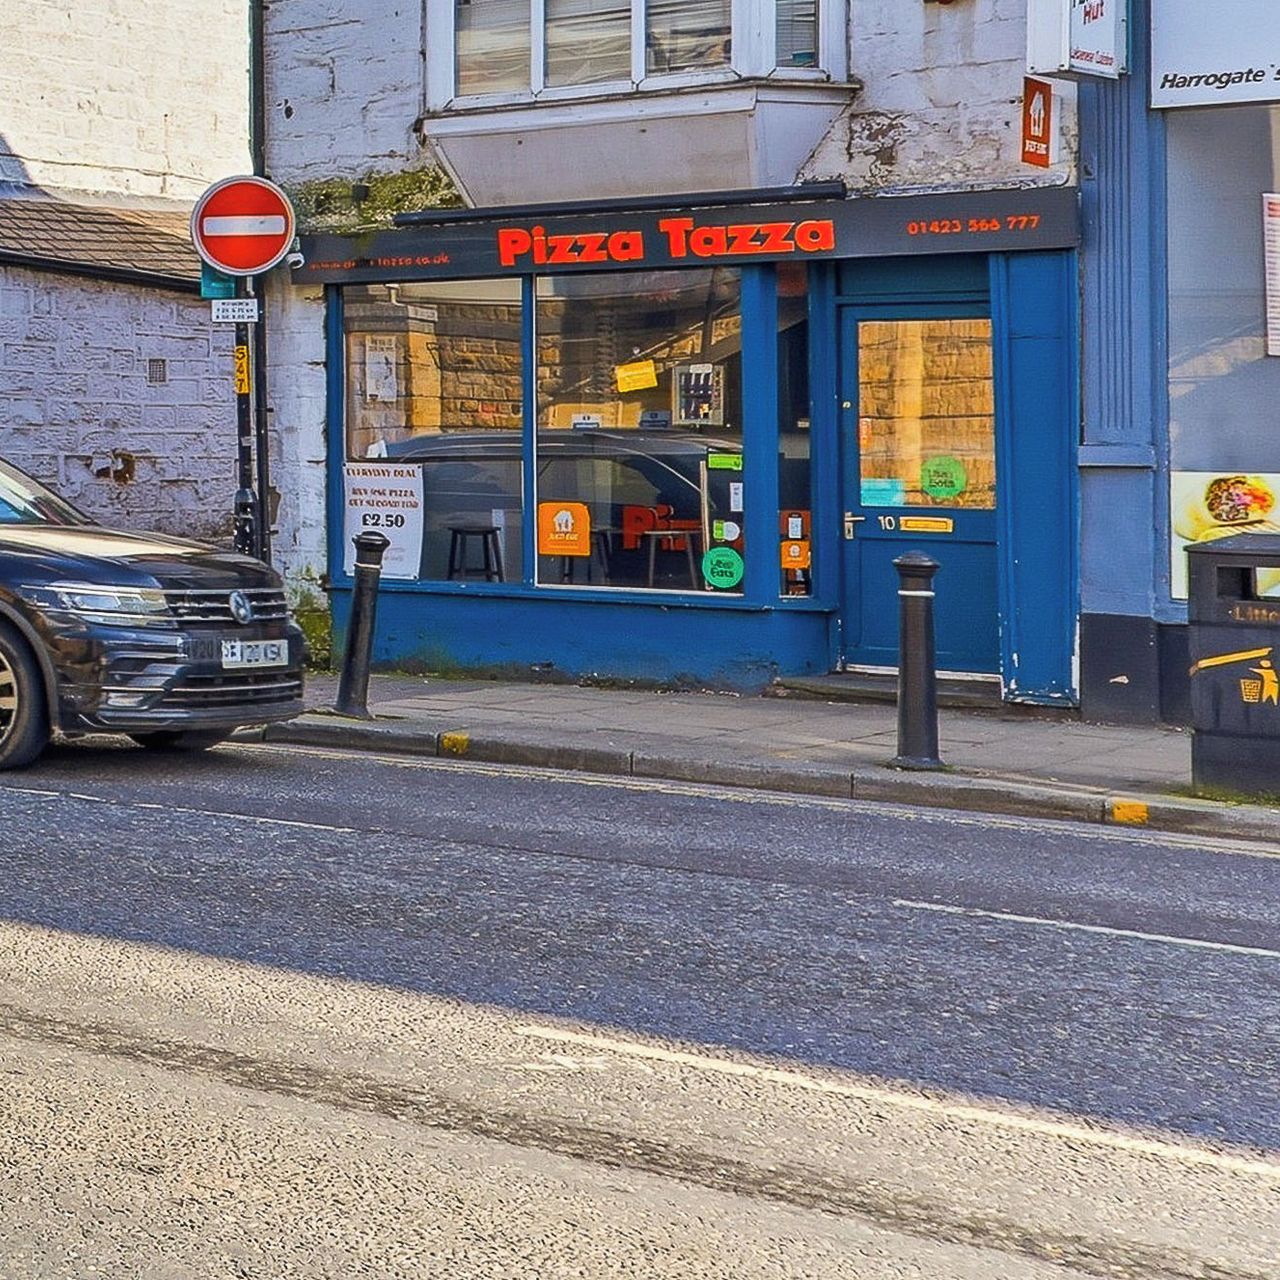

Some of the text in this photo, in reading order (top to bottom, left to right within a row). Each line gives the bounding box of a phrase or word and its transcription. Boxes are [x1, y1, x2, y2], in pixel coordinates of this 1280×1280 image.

[1083, 0, 1104, 25] Hut
[907, 220, 961, 235] 01423
[1007, 216, 1040, 230] 777
[393, 469, 416, 478] DEAL
[362, 513, 405, 528] £2.50
[878, 516, 895, 530] 10
